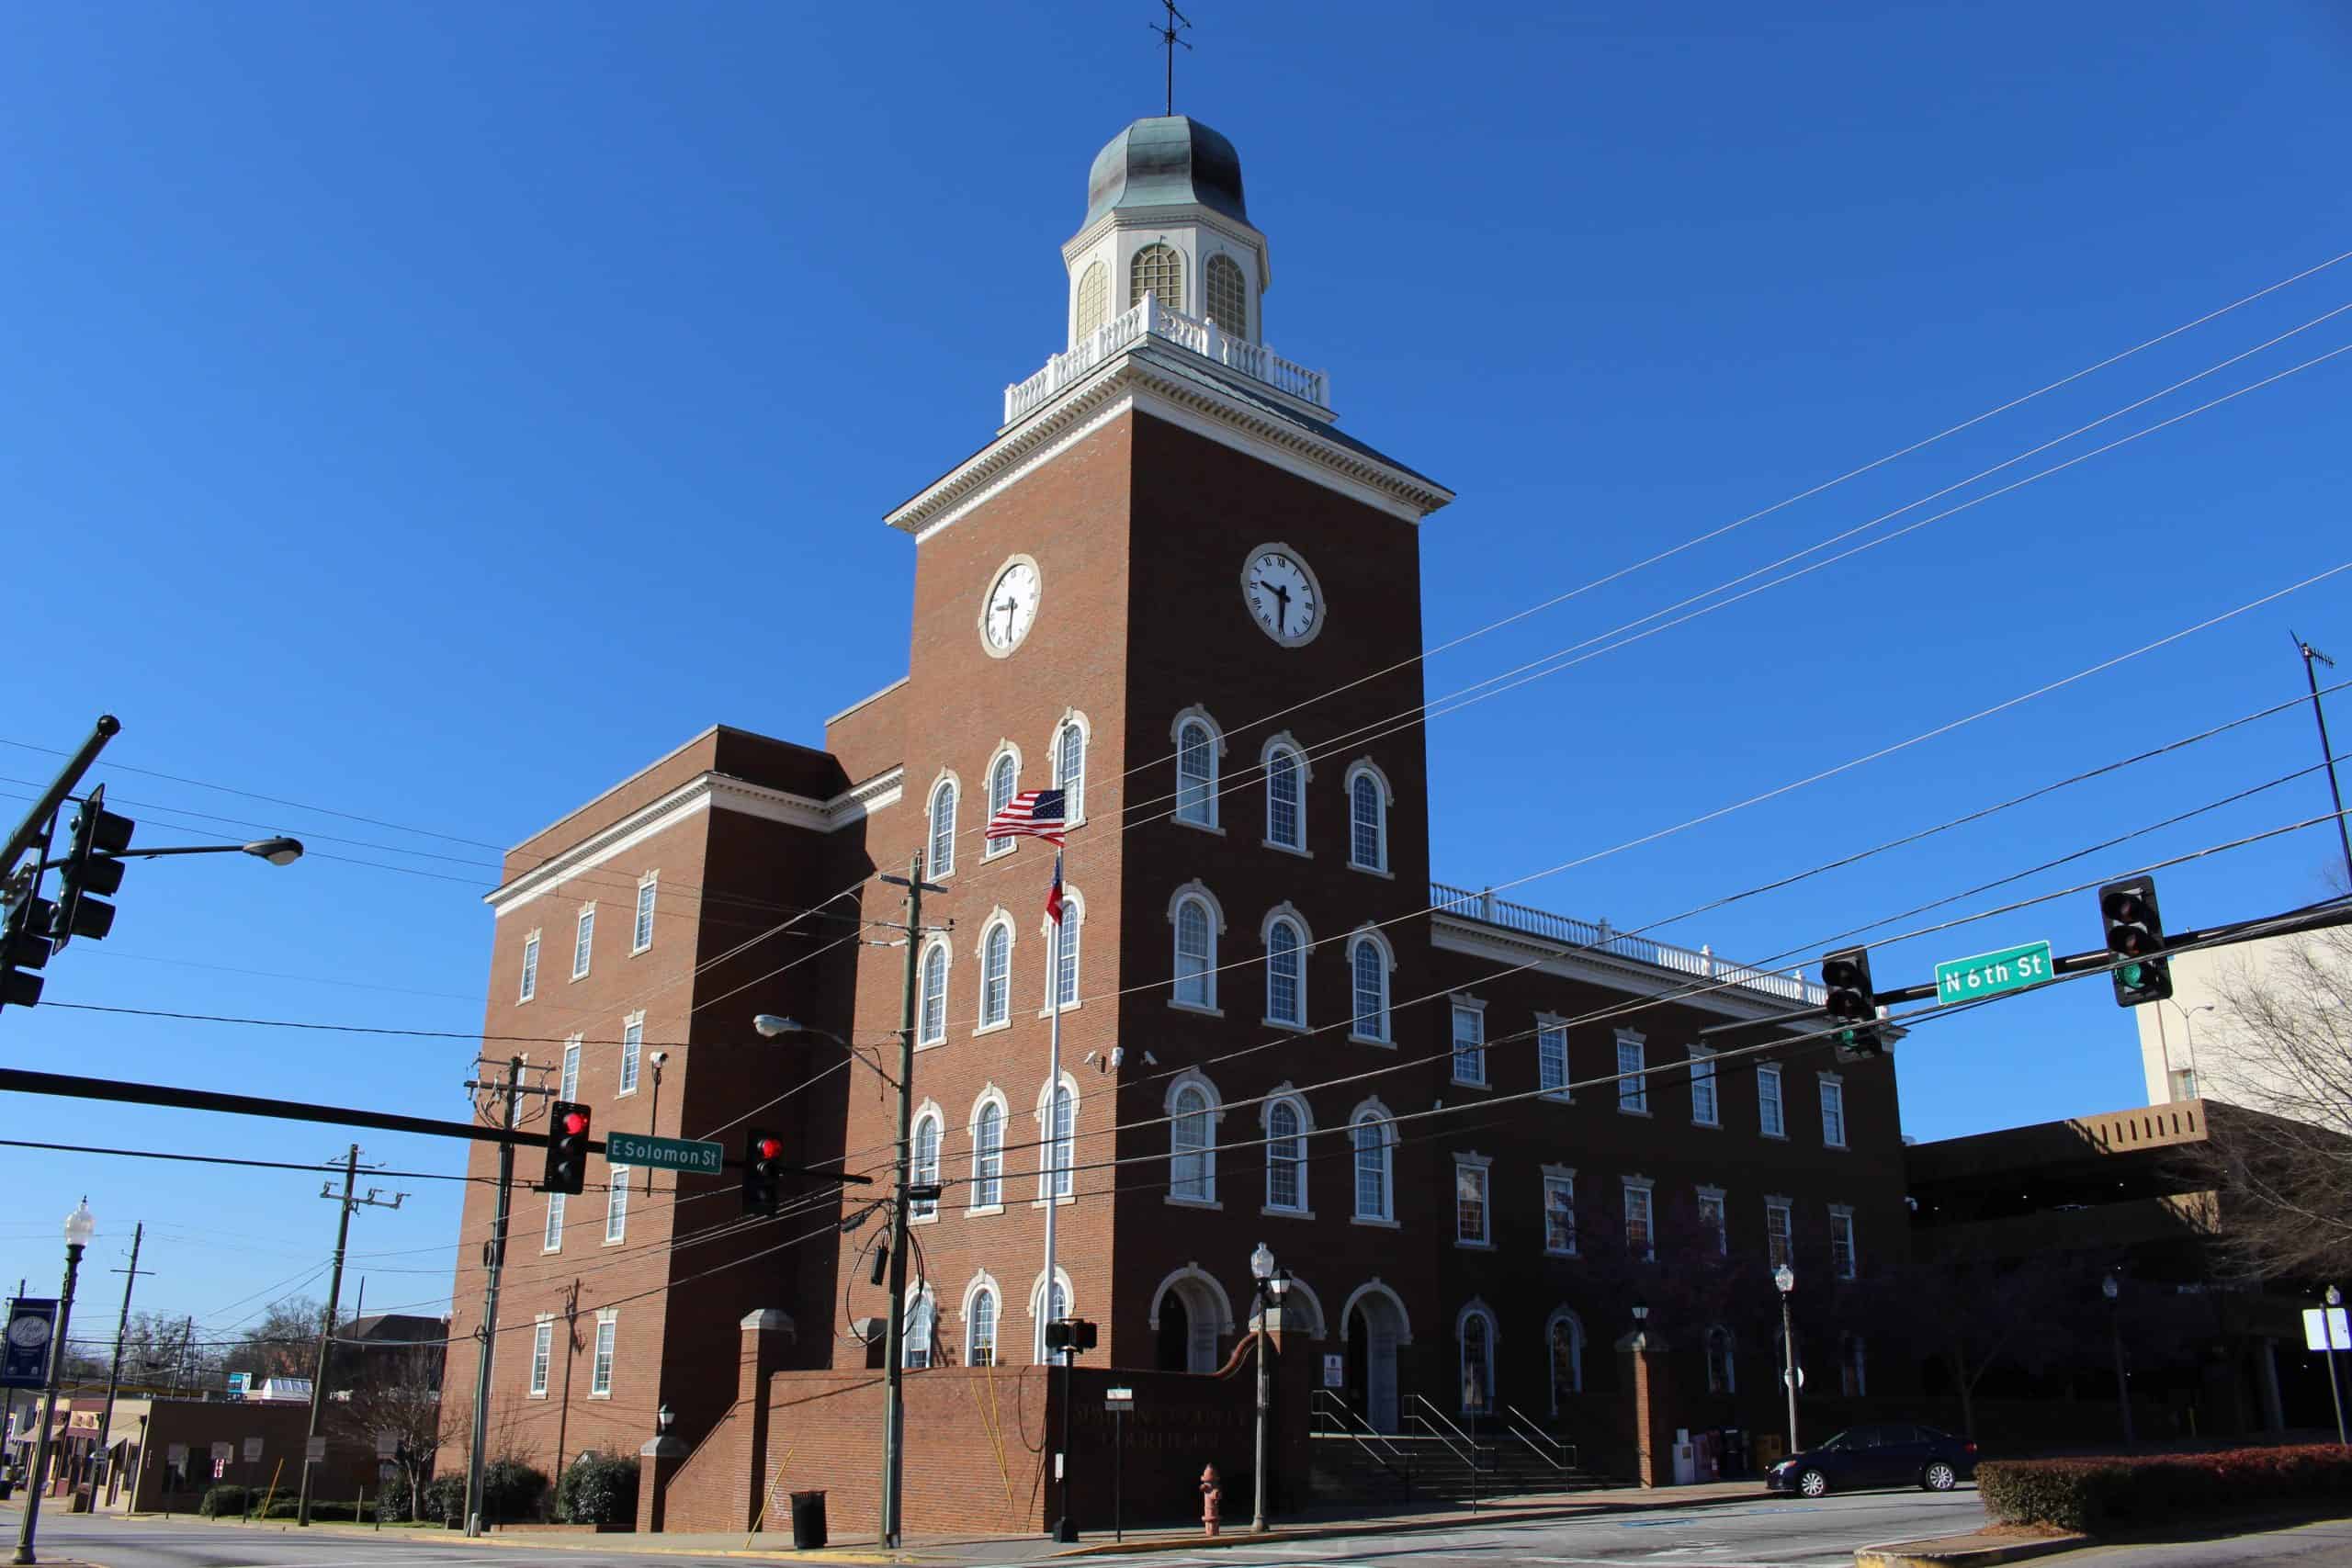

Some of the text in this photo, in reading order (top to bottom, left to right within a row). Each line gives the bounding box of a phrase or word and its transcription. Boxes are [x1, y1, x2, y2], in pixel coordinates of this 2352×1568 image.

[1946, 954, 2042, 992] N 6th St
[612, 1140, 716, 1166] E Solomon St
